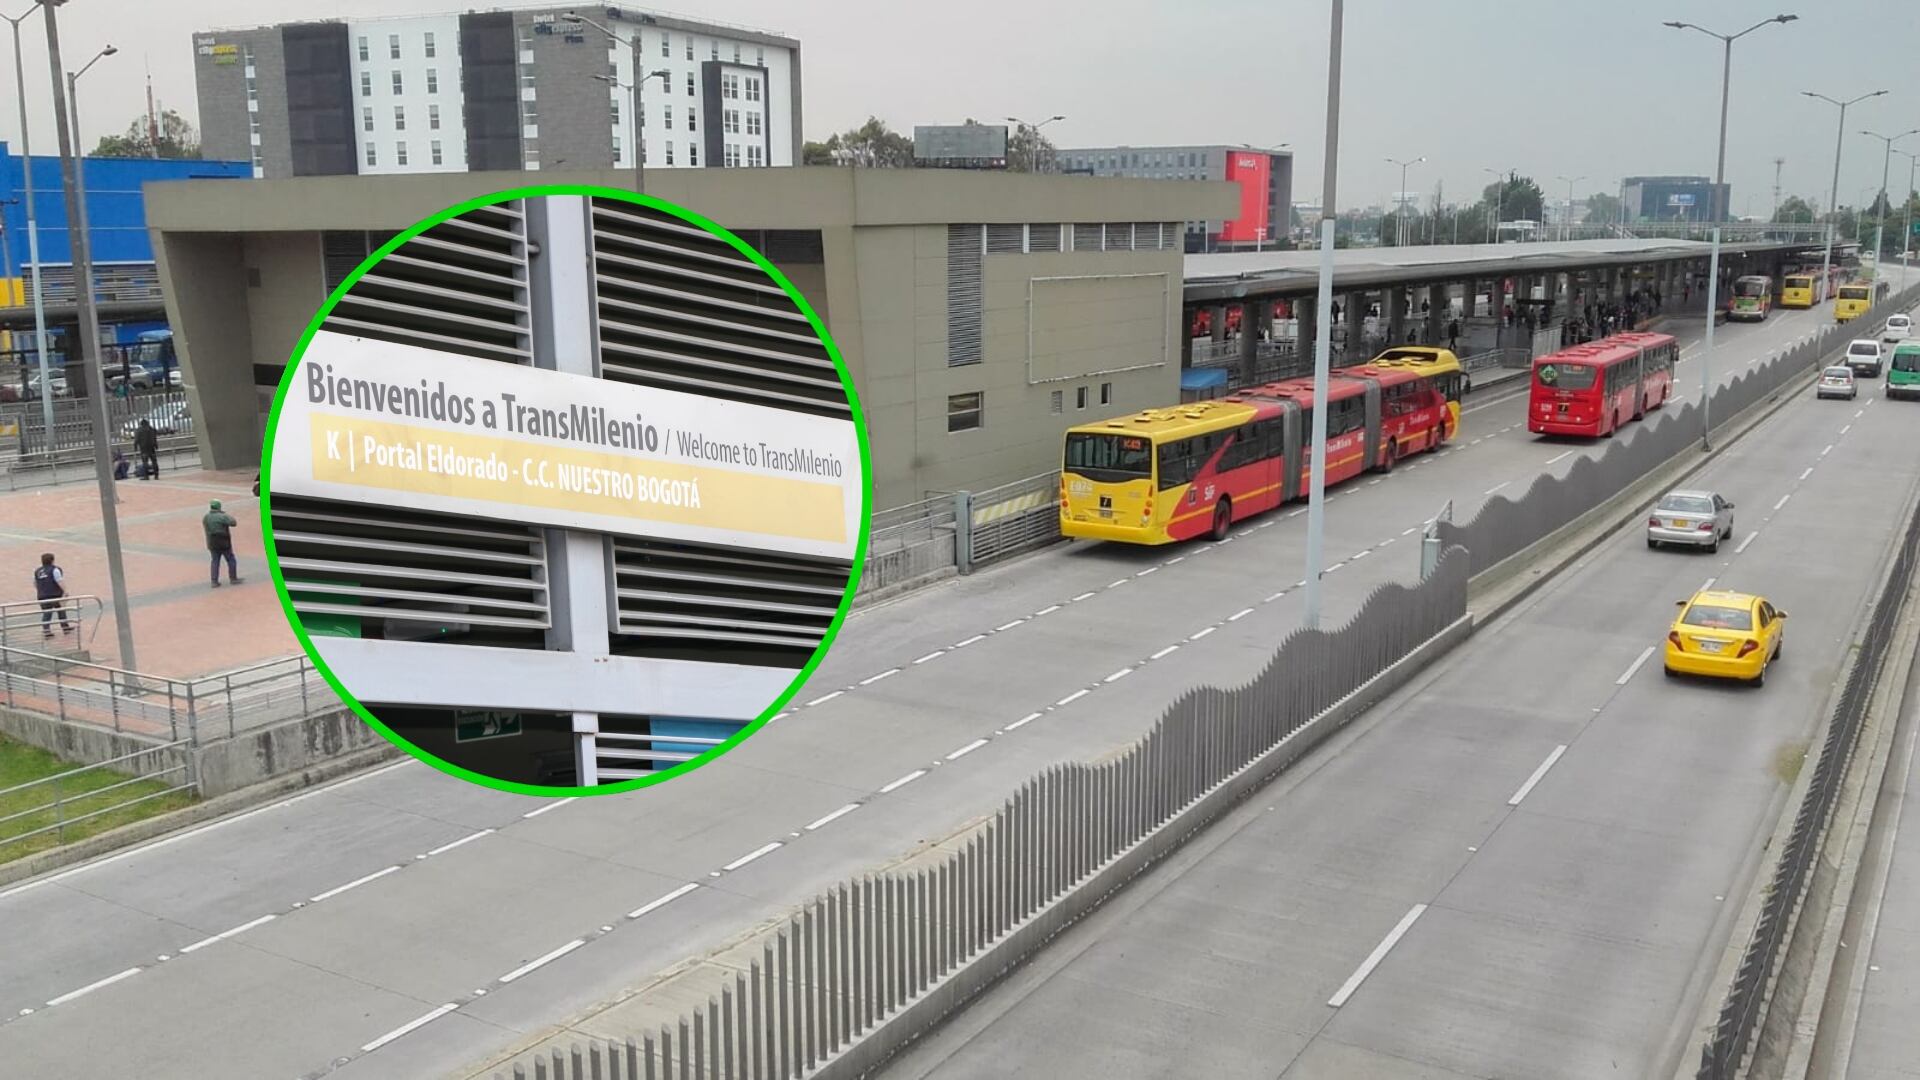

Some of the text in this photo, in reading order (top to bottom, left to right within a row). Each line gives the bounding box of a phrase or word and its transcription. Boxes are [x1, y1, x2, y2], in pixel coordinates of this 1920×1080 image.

[306, 361, 476, 426] Bienvenidos
[482, 399, 497, 430] a
[501, 393, 659, 453] TransMilenio
[676, 430, 741, 464] Welcome
[743, 442, 757, 467] to
[759, 442, 843, 478] TransMilenio
[326, 430, 342, 461] K
[363, 435, 423, 472] Portal
[427, 443, 509, 483] Eldorado
[522, 457, 555, 489] C.C.
[558, 463, 634, 501] NUESTRO
[637, 476, 701, 509] BOGOTÁ
